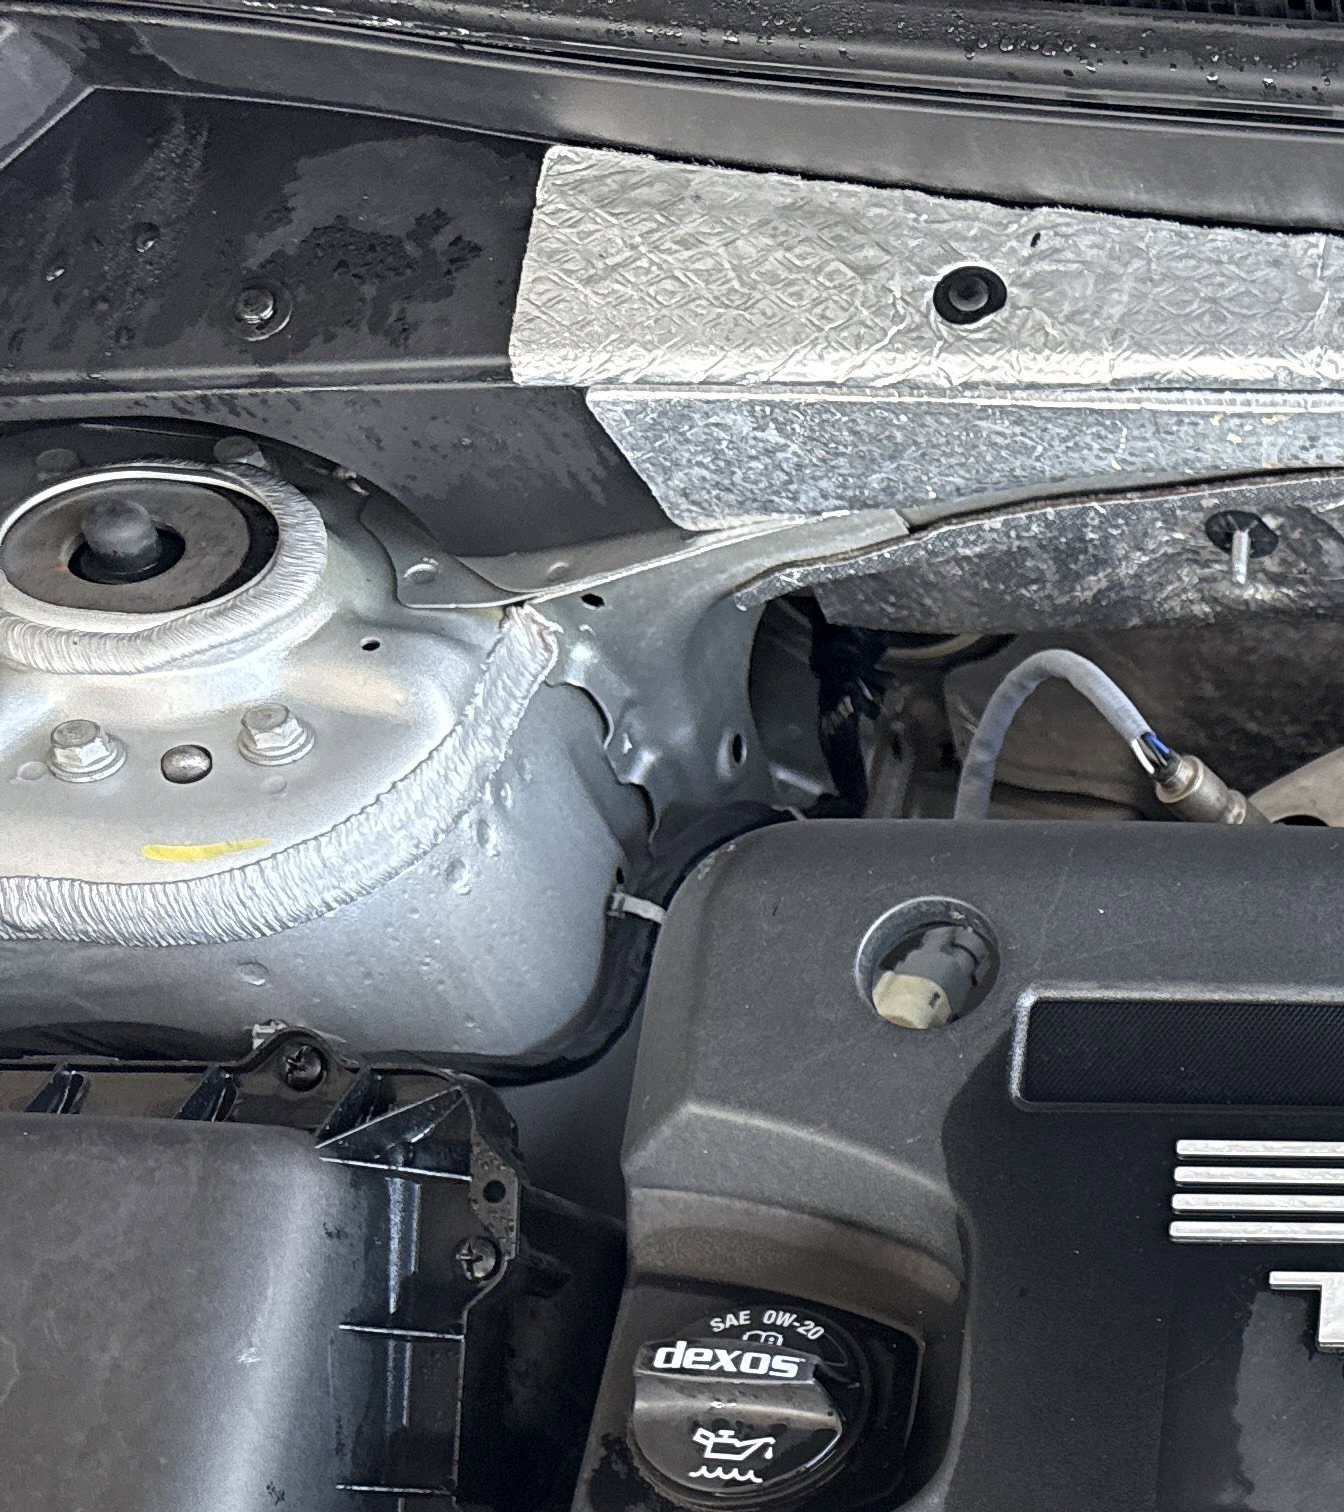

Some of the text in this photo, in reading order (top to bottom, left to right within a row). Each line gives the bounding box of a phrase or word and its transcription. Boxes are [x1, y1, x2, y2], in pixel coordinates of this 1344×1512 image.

[709, 1309, 825, 1341] SAE 0W-20
[653, 1341, 805, 1378] dexos
